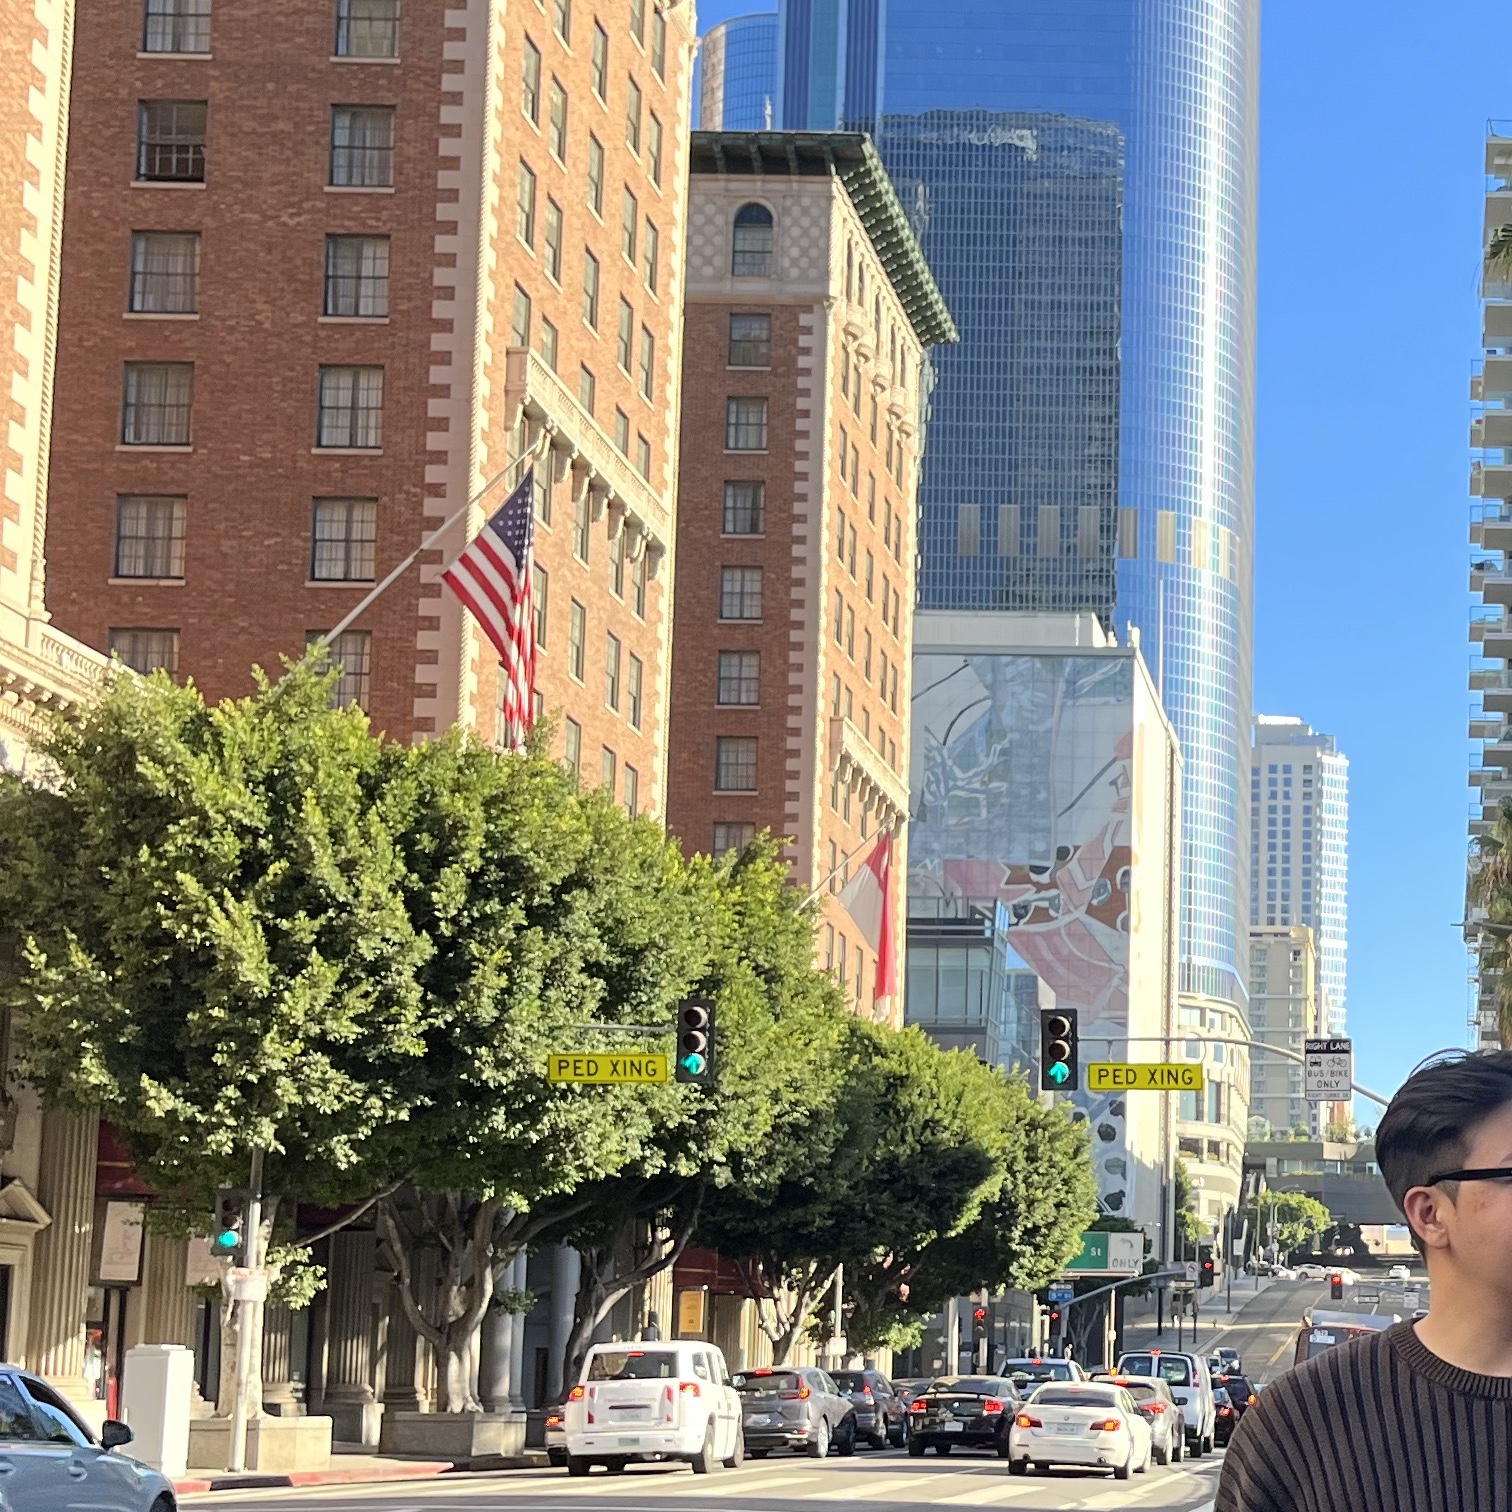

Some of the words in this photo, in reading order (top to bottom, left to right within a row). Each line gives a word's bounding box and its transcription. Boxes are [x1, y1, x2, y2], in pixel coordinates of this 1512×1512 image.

[1306, 1041, 1328, 1050] RIGHT
[1330, 1041, 1350, 1050] LANE
[558, 1060, 599, 1076] PED
[610, 1060, 657, 1076] XING
[1098, 1068, 1137, 1085] PED
[1148, 1068, 1193, 1085] XING
[1316, 1080, 1340, 1088] ONLY
[1090, 1247, 1102, 1257] St
[1111, 1258, 1140, 1268] ONLY
